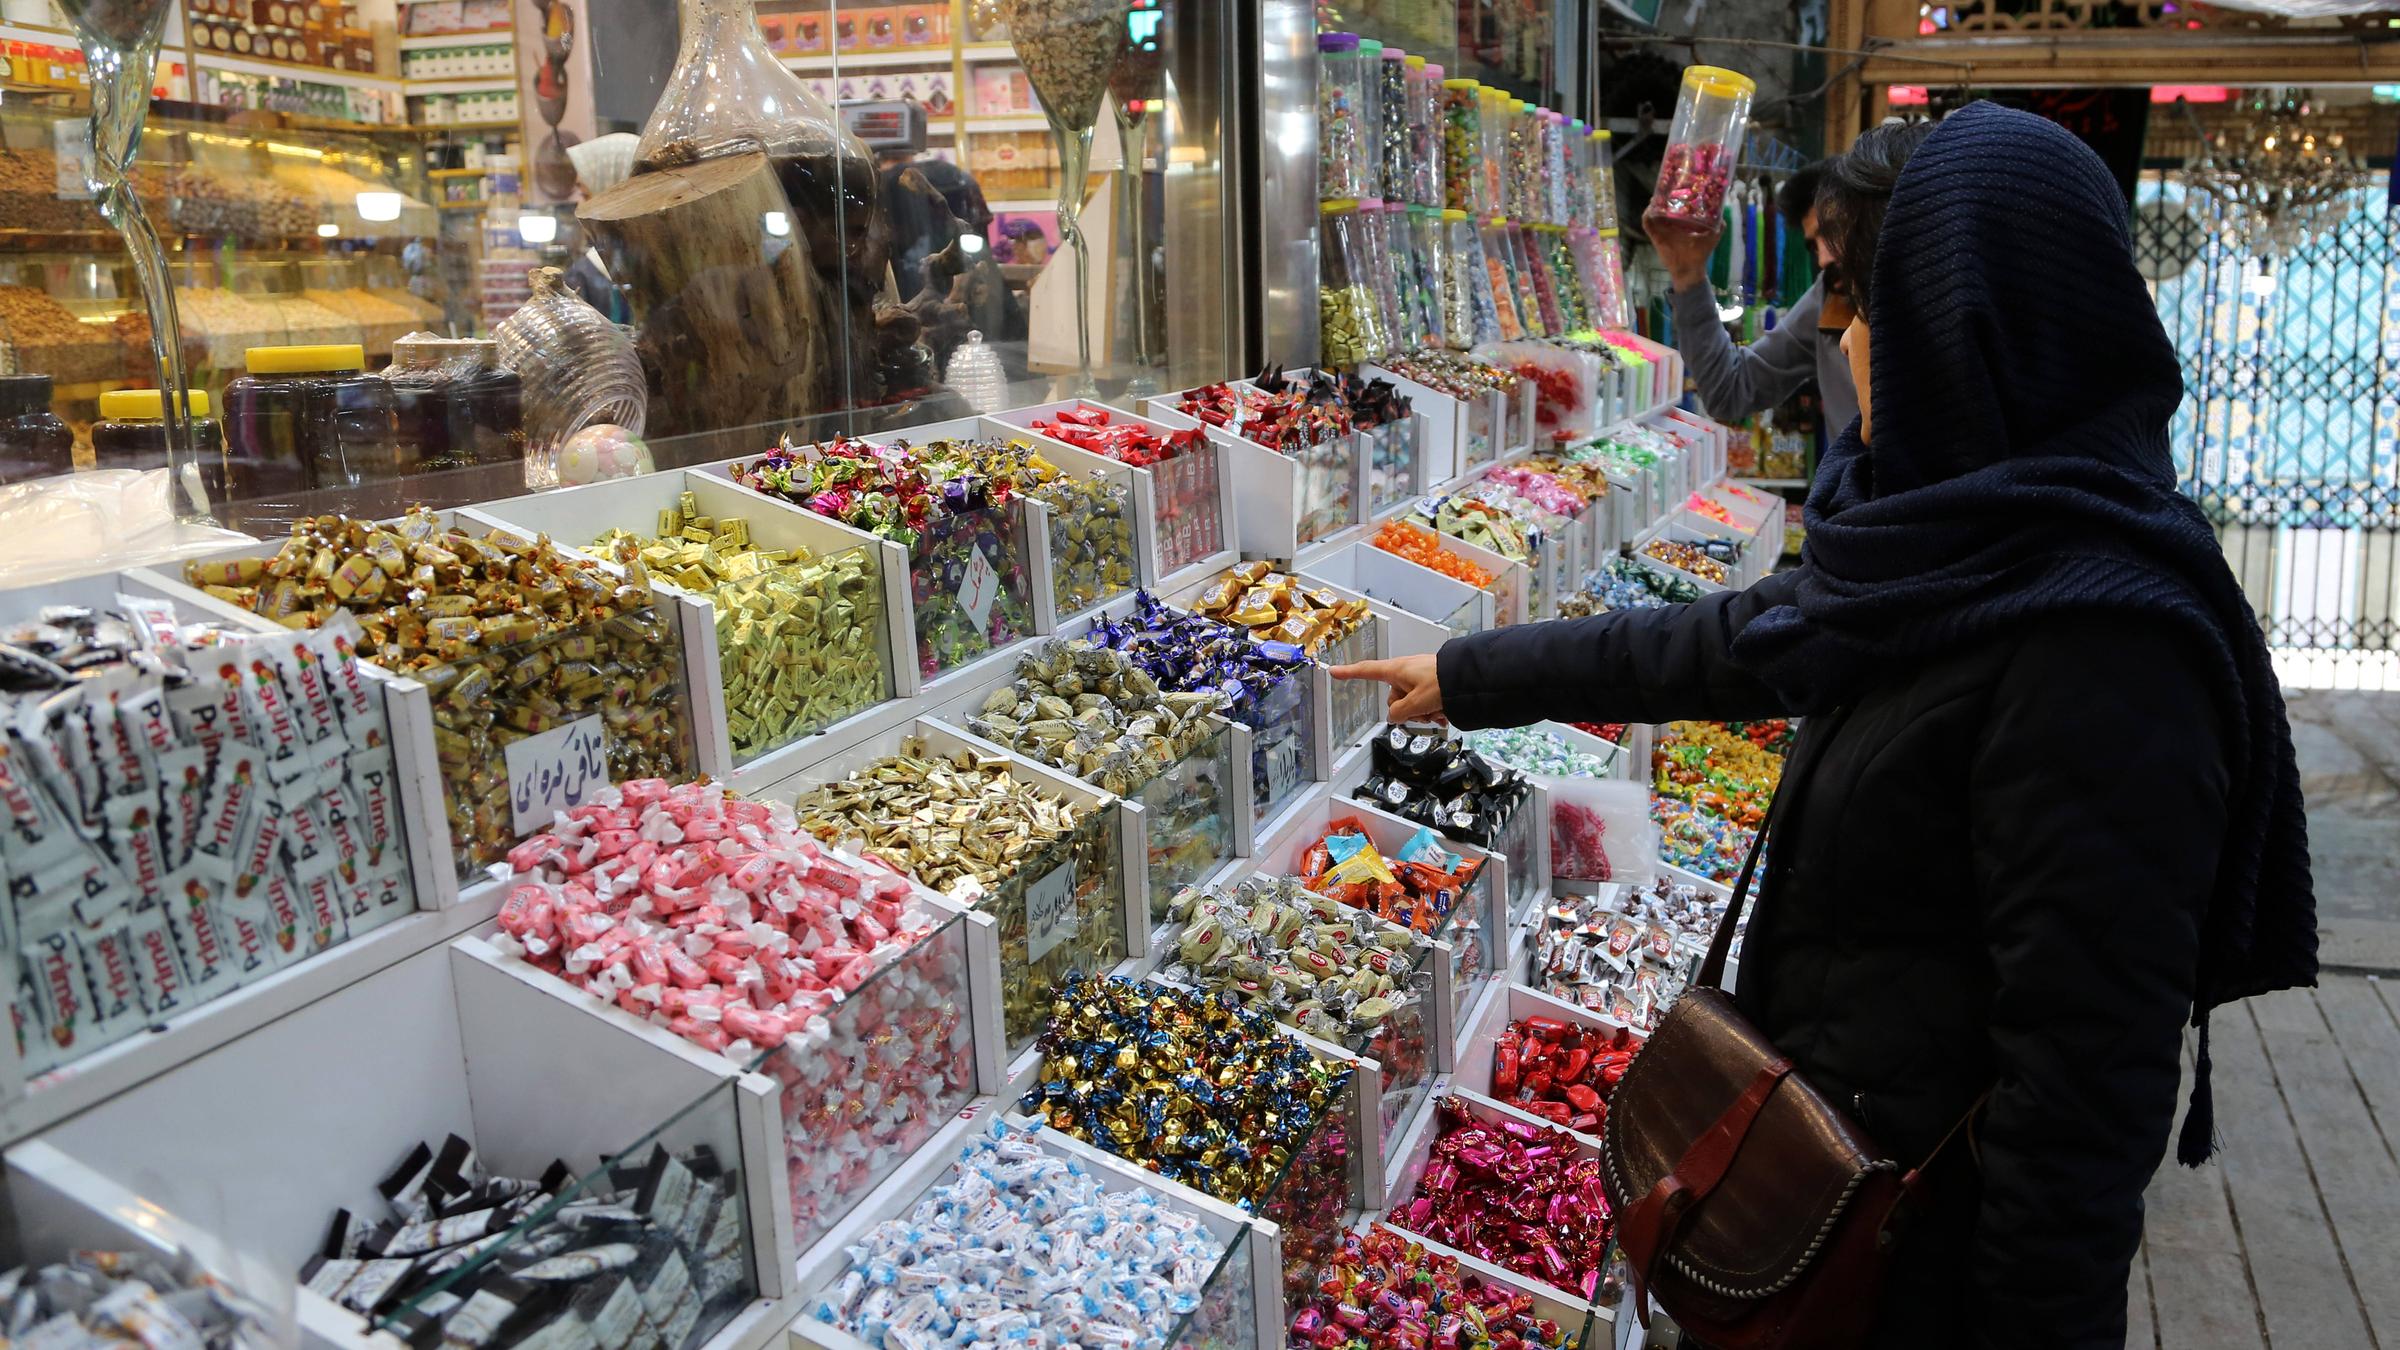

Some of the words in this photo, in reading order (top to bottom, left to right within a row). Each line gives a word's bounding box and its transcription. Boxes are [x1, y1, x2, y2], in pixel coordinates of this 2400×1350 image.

[259, 685, 295, 762] Prime
[202, 782, 244, 858] Prime
[251, 800, 284, 876] Prime
[364, 770, 390, 843] Prime
[38, 932, 81, 1018] Prime
[98, 934, 130, 1018] Prime
[144, 929, 179, 1012] Prime
